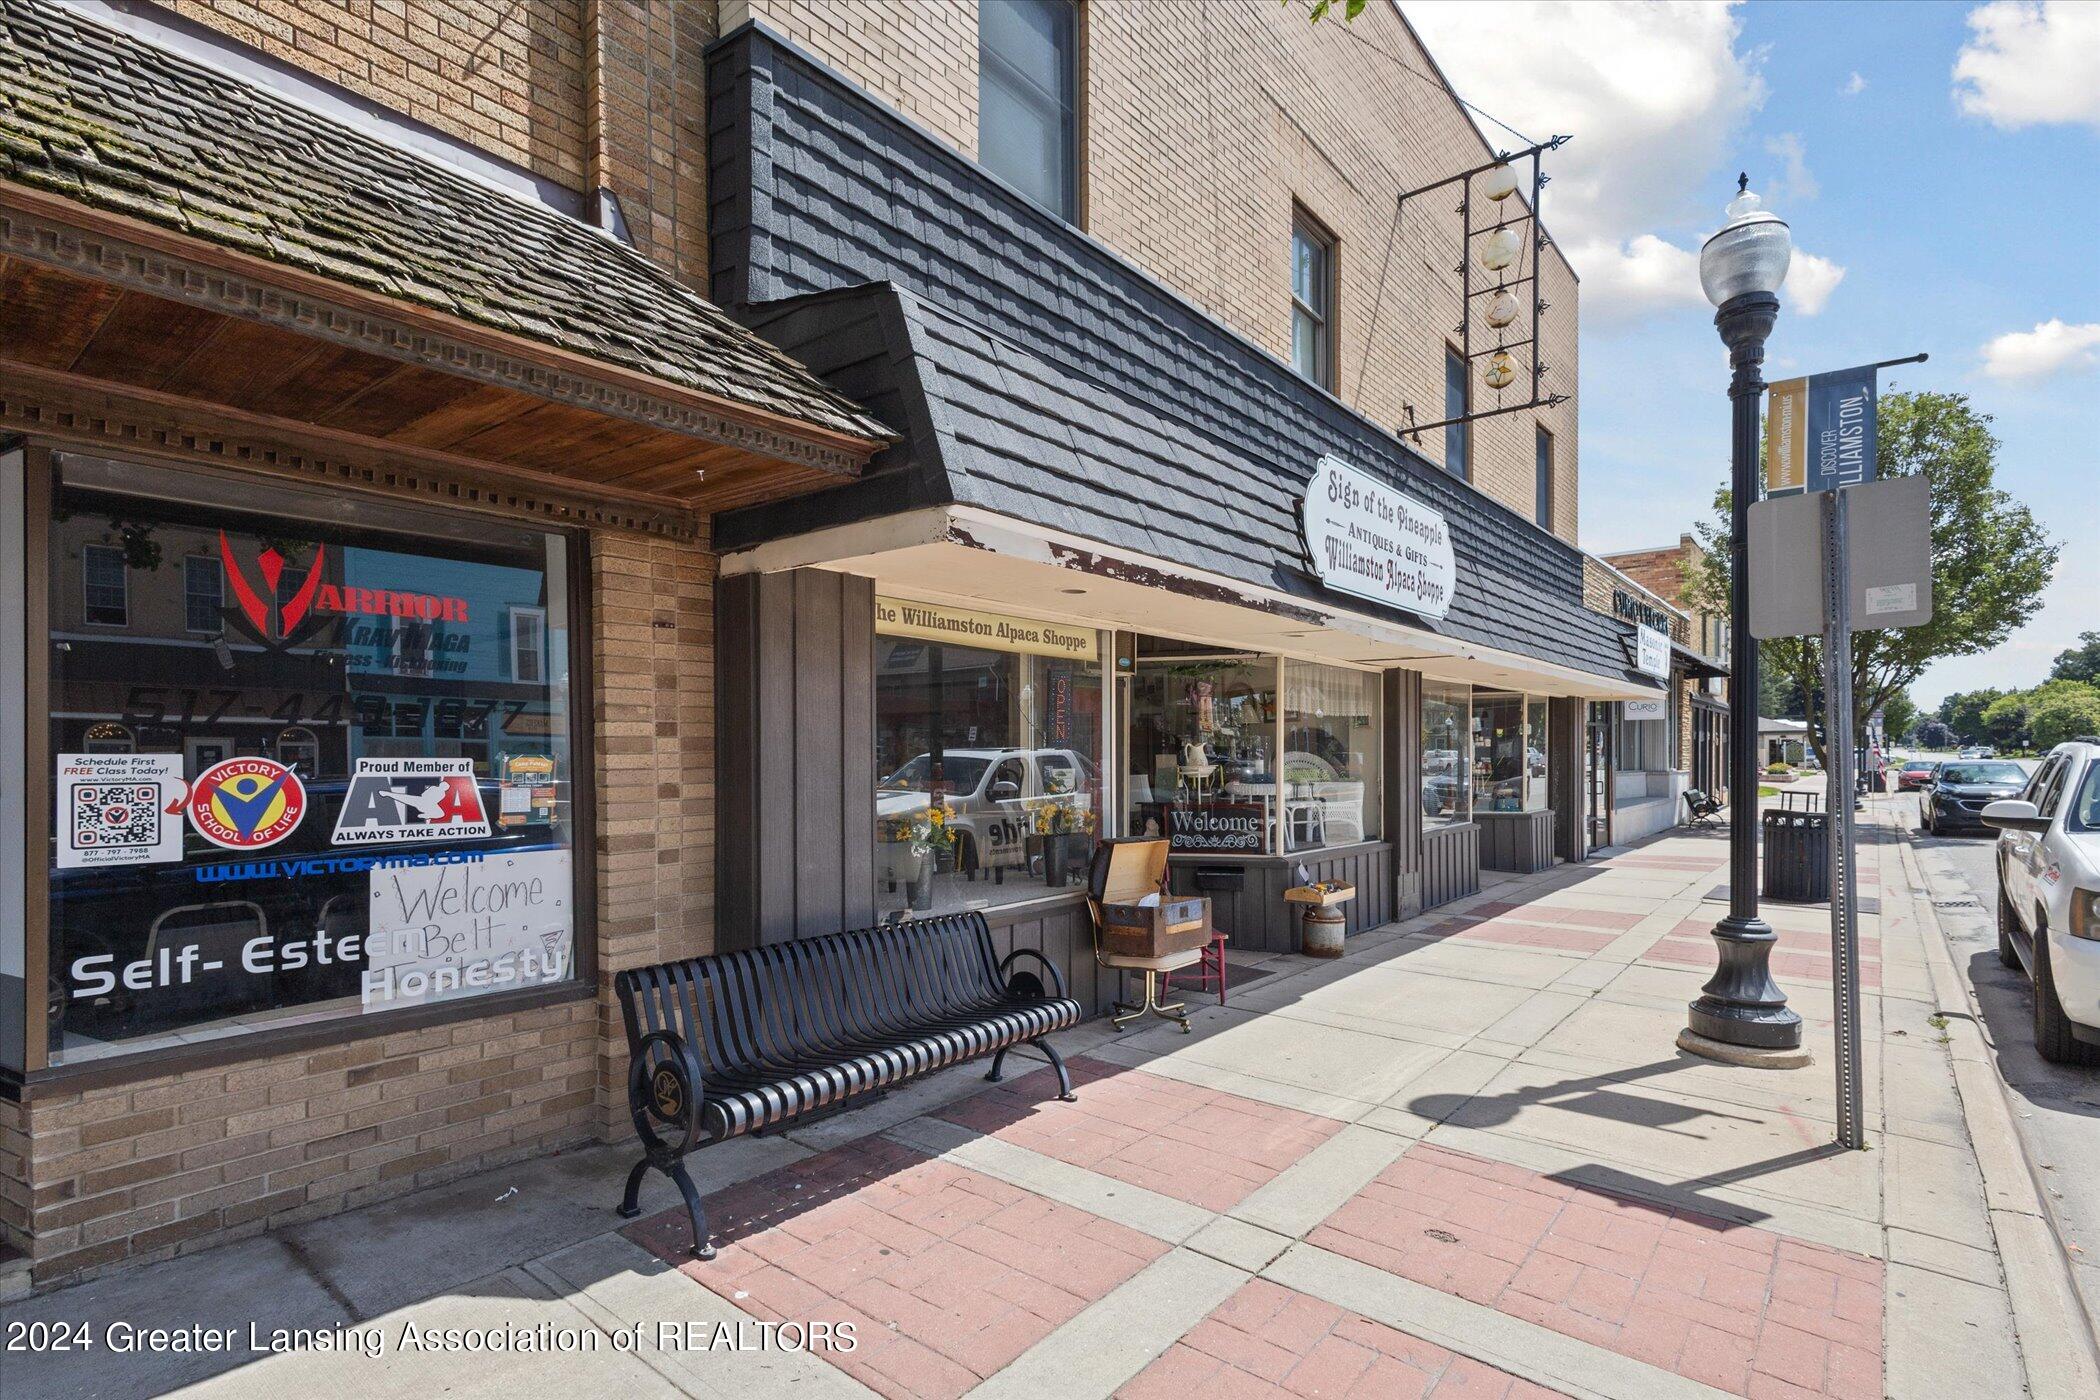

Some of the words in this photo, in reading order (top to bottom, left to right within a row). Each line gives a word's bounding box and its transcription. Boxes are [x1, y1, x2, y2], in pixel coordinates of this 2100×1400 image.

[1821, 429, 1837, 476] DISCOVER
[1839, 395, 1863, 489] ILLIAMSTON
[1328, 470, 1360, 509] Sign
[1364, 491, 1375, 513] of
[1377, 497, 1394, 523] the
[1397, 504, 1442, 547] Pineapple
[1348, 522, 1394, 551] ANTIQUES
[1396, 545, 1403, 555] &
[1405, 545, 1428, 567] GIFTS
[1325, 535, 1384, 580] Williamston
[1385, 558, 1415, 593] Alpaca
[1416, 570, 1444, 606] Shoppe
[901, 606, 992, 636] Williamston
[996, 622, 1040, 644] Alpaca
[1043, 628, 1087, 651] Shoppe
[1056, 679, 1066, 740] OPEN
[63, 767, 94, 775] FREE
[97, 767, 127, 775] Class
[131, 767, 169, 776] Today!
[75, 758, 128, 766] Schedule
[131, 758, 156, 766] First
[211, 763, 280, 781] VICTORY
[360, 761, 398, 772] Proud
[404, 761, 454, 772] Member
[458, 761, 470, 772] of
[198, 803, 241, 842] SCHOOL
[253, 828, 274, 841] OF
[274, 806, 298, 831] LIFE
[340, 776, 485, 827] ATA
[1171, 811, 1258, 831] Welcome
[336, 830, 394, 842] ALWAYS
[398, 829, 434, 838] TAKE
[438, 827, 486, 836] ACTION
[393, 866, 544, 924] Welcome
[241, 930, 427, 974] Esteem
[418, 916, 506, 960] Belt
[362, 947, 562, 1005] Honesty
